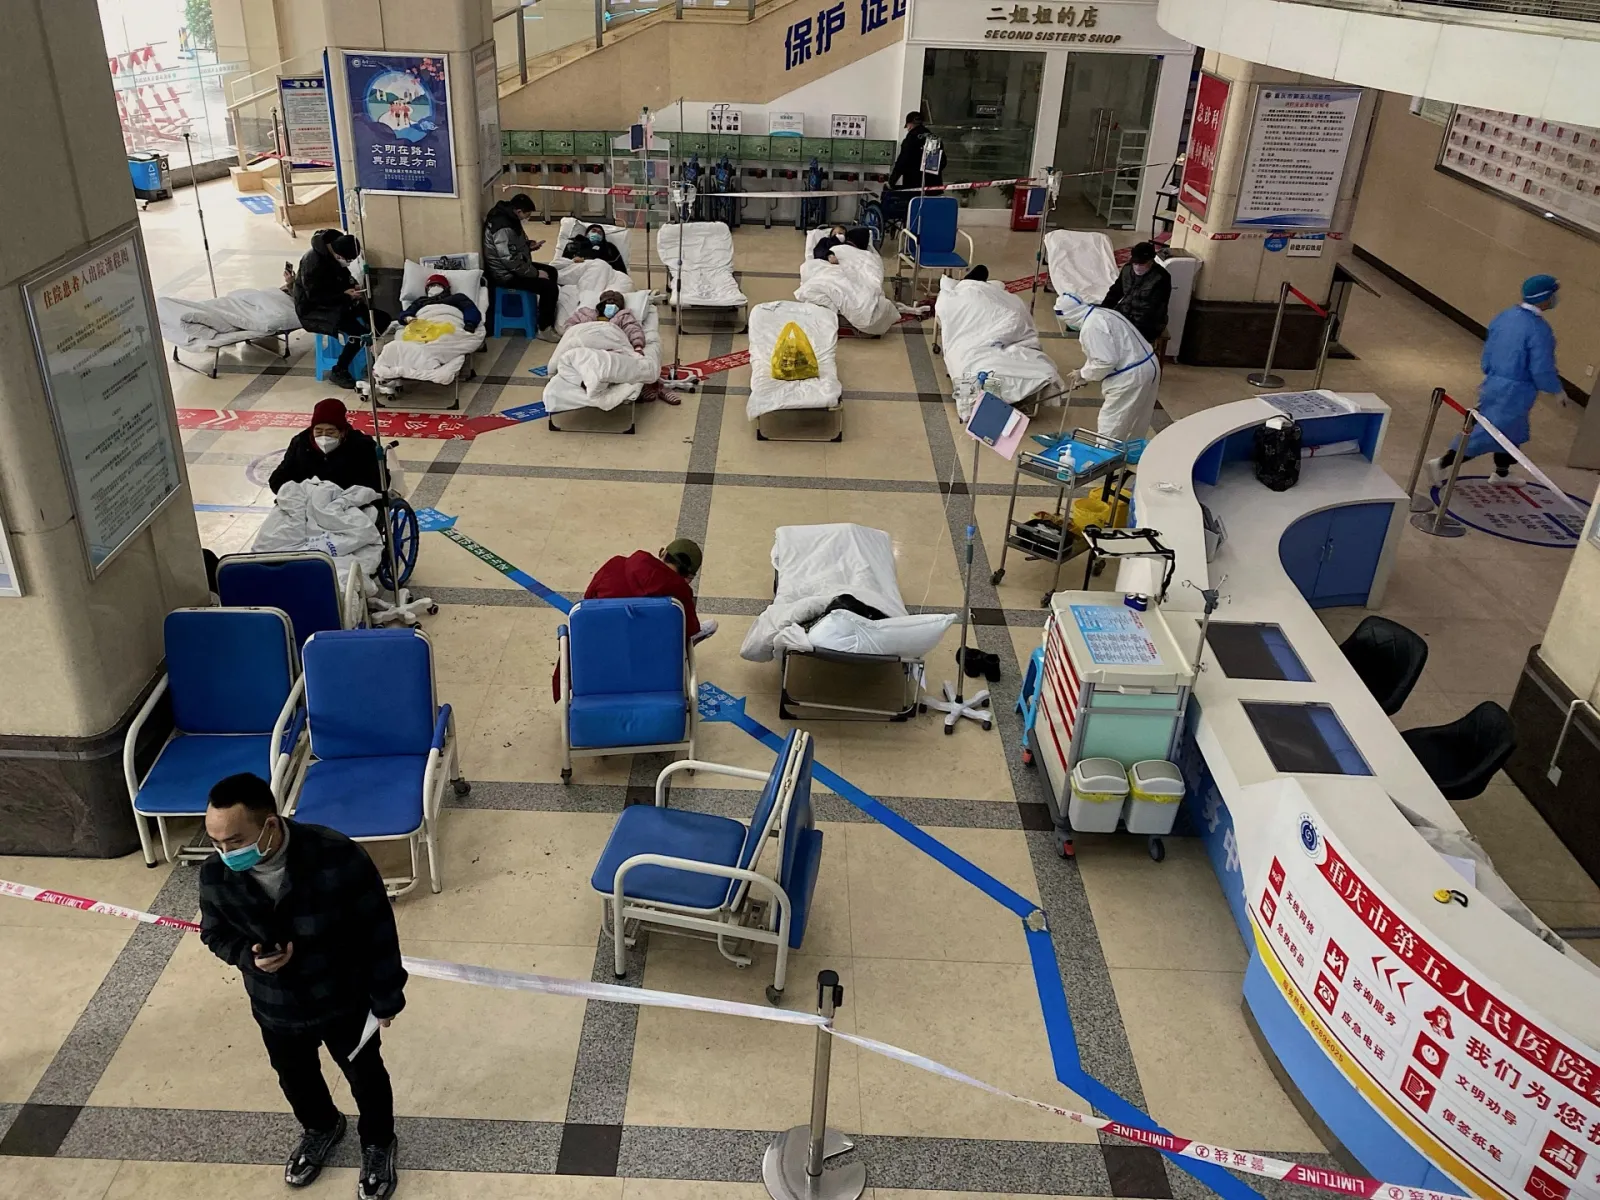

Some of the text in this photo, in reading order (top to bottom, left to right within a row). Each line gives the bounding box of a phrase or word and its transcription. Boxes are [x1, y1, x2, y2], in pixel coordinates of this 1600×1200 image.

[785, 1, 845, 71] 保护
[984, 29, 1122, 44] SECOND SISTER'S SHOP
[986, 4, 1099, 28] 二姐姐的店
[372, 144, 436, 157] 文明在路上
[372, 156, 437, 168] 典范是方向
[42, 892, 84, 909] LIMITLINE
[1286, 890, 1315, 936] 无线网络
[1276, 923, 1305, 968] 急救药品
[1328, 857, 1600, 1103] 重庆市第五人民医院
[1352, 976, 1397, 1027] 咨询服务
[1310, 1019, 1344, 1062] 62896025
[1341, 1011, 1386, 1061] 应急电话
[1455, 1074, 1518, 1126] 文明劝导
[1113, 1124, 1174, 1149] LIMITLINE
[1442, 1108, 1504, 1163] 便签纸笔
[1214, 1148, 1265, 1172] 警戒线
[1297, 1167, 1365, 1193] LIMITLINE
